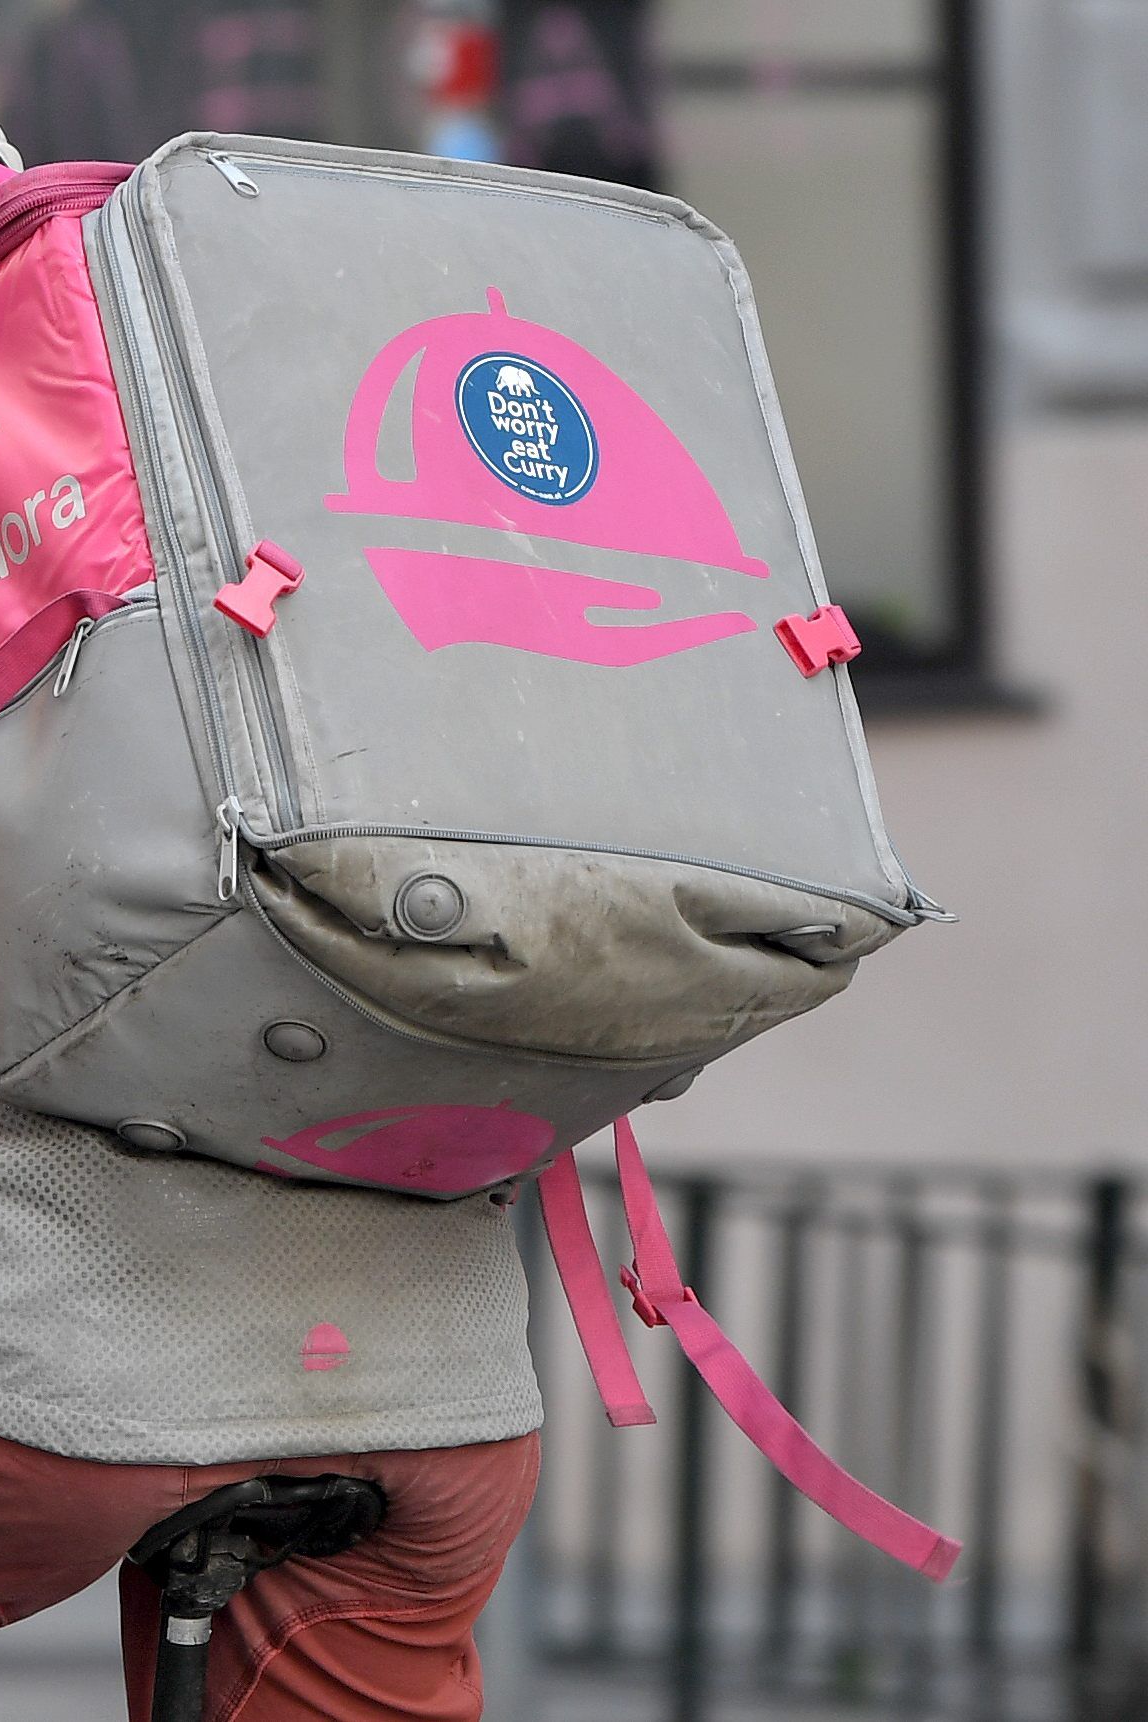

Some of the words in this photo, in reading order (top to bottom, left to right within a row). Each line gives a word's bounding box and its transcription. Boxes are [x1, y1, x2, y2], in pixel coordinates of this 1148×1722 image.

[487, 391, 555, 422] Don't
[490, 414, 559, 445] worry
[512, 438, 552, 461] eat
[503, 451, 568, 488] Curry
